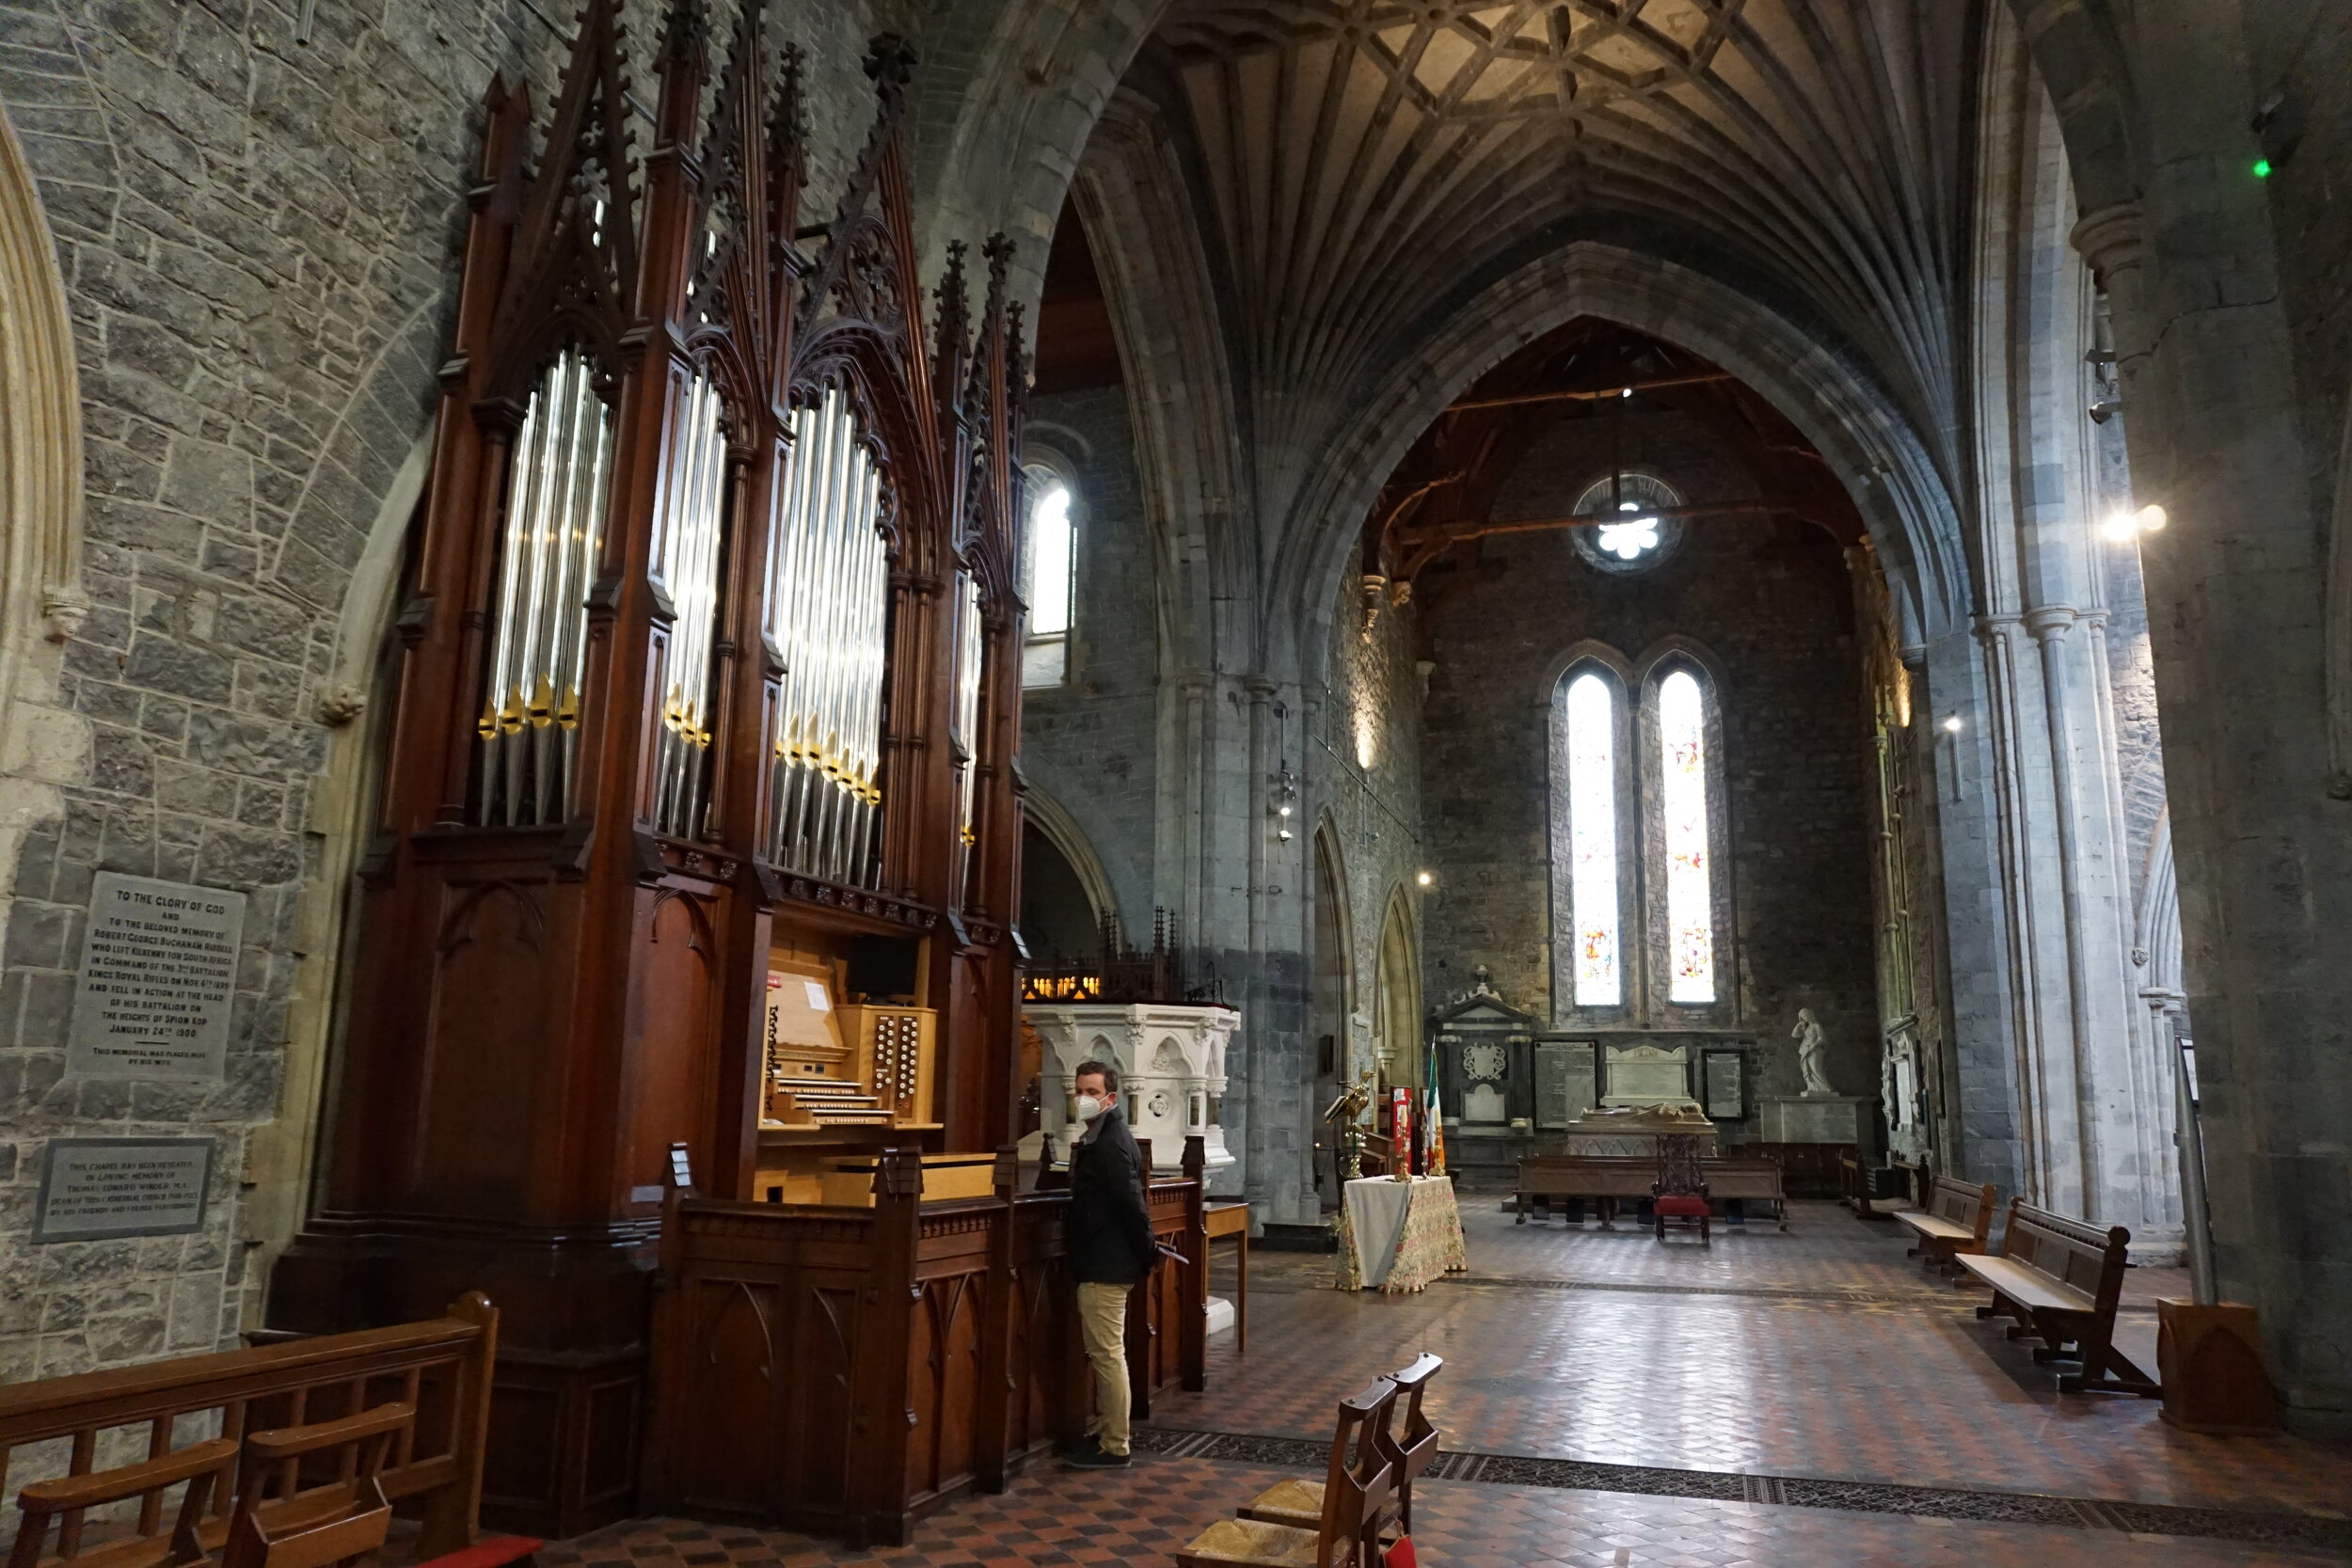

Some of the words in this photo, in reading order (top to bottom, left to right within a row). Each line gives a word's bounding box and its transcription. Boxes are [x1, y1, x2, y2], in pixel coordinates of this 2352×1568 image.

[117, 890, 130, 900] TO
[134, 893, 152, 904] THE
[156, 896, 187, 909] GLORY
[190, 902, 202, 911] OF
[206, 904, 224, 915] GOD
[162, 912, 180, 920] AND
[126, 920, 140, 928] THE
[144, 922, 178, 934] BELOVED
[181, 927, 213, 938] MEMORY
[94, 929, 126, 941] ROBERT
[128, 933, 159, 945] GEORGE
[160, 937, 202, 950] BUCHANAN
[91, 943, 111, 952] WHO
[113, 946, 129, 955] LEFT
[132, 948, 166, 958] KILKENNY
[183, 953, 207, 963] SOUTH
[208, 956, 231, 964] AFRICA
[103, 957, 147, 969] COMMAND
[161, 963, 175, 972] THE
[190, 966, 228, 977] BATTALION
[115, 972, 140, 982] ROYAL
[144, 974, 168, 984] RIFLES
[89, 984, 107, 992] AND
[112, 985, 128, 994] FELL
[144, 989, 173, 997] ACTION
[188, 992, 201, 1000] THE
[142, 1001, 186, 1012] BATTALION
[120, 1013, 149, 1022] HEIGHTS
[165, 1015, 189, 1025] SPION
[192, 1017, 207, 1026] KOP
[109, 1025, 149, 1035] JANUARY
[176, 1028, 196, 1037] 1900
